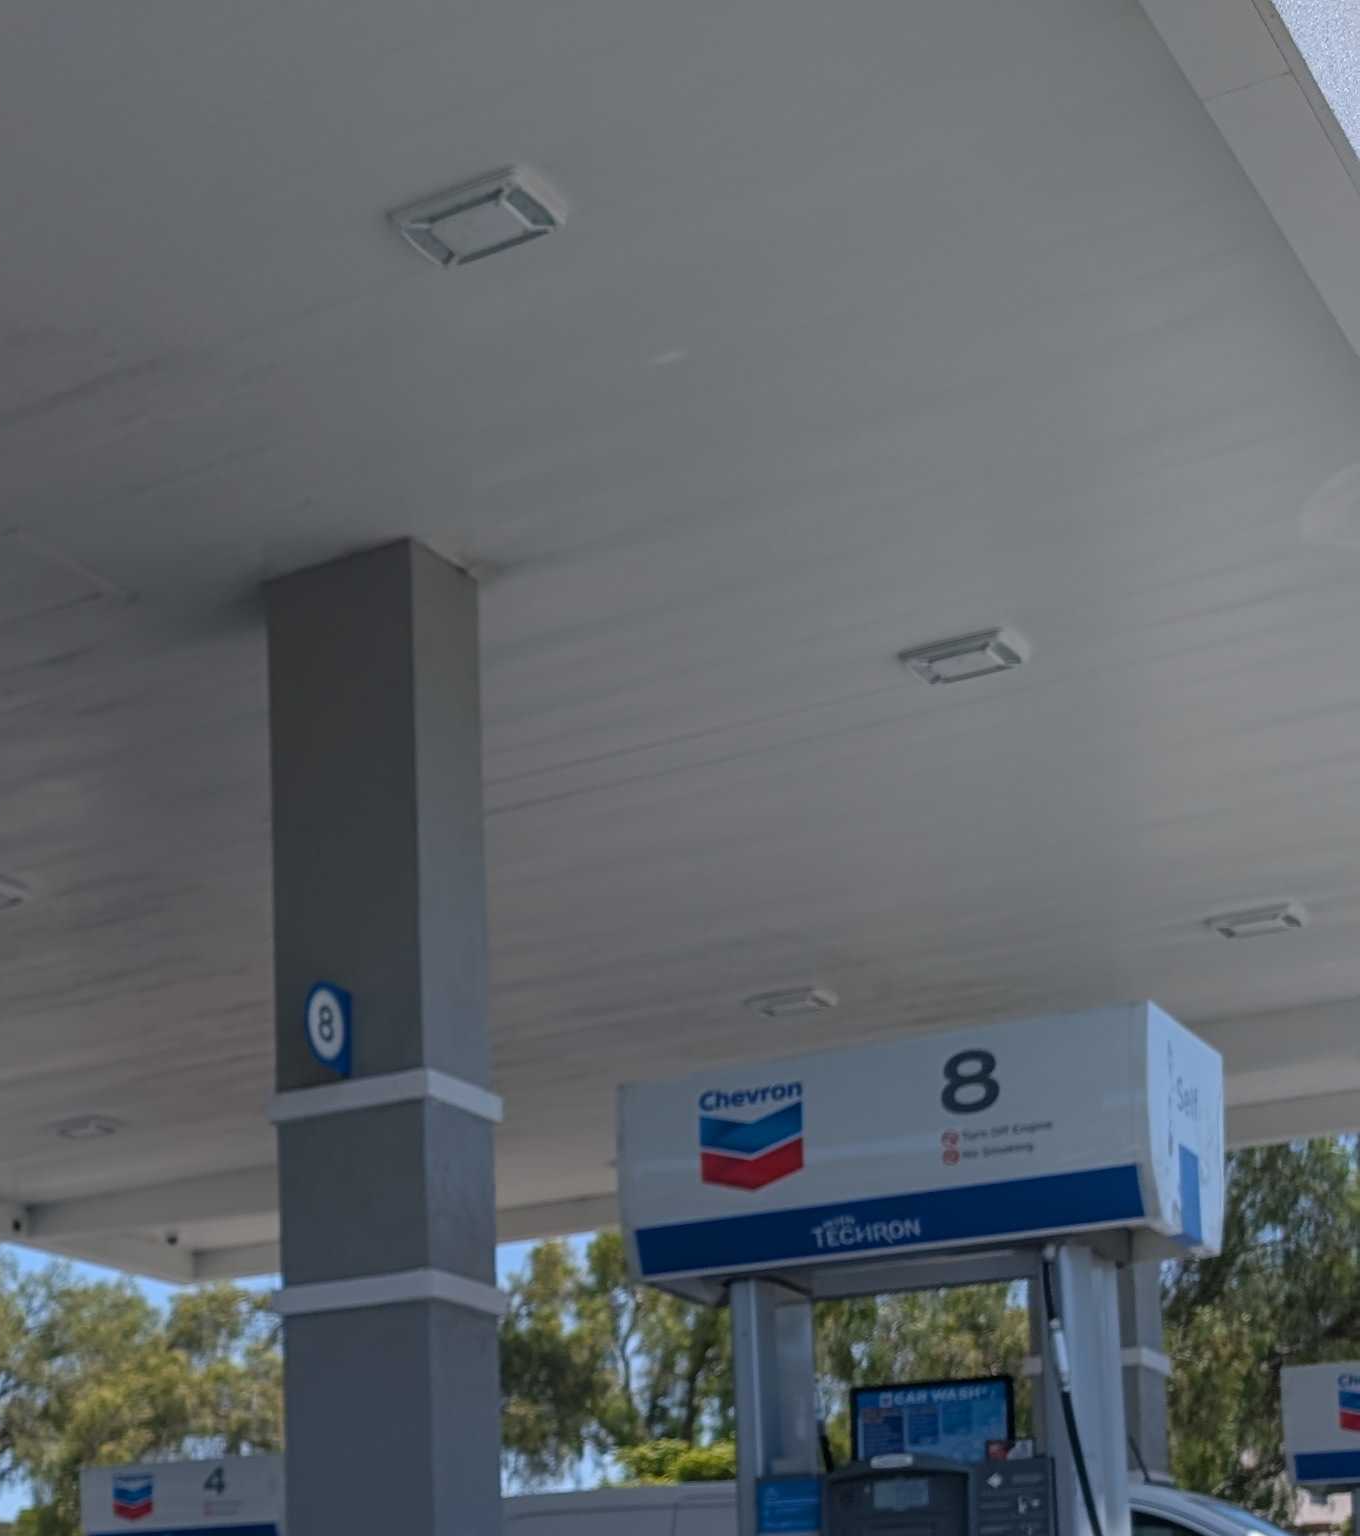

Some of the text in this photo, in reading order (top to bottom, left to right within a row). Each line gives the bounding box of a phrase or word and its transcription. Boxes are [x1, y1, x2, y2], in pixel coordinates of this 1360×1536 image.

[318, 1004, 334, 1043] 8
[698, 1048, 1000, 1115] Chevron 8
[810, 1217, 922, 1249] TECHRON
[202, 1465, 226, 1495] 4
